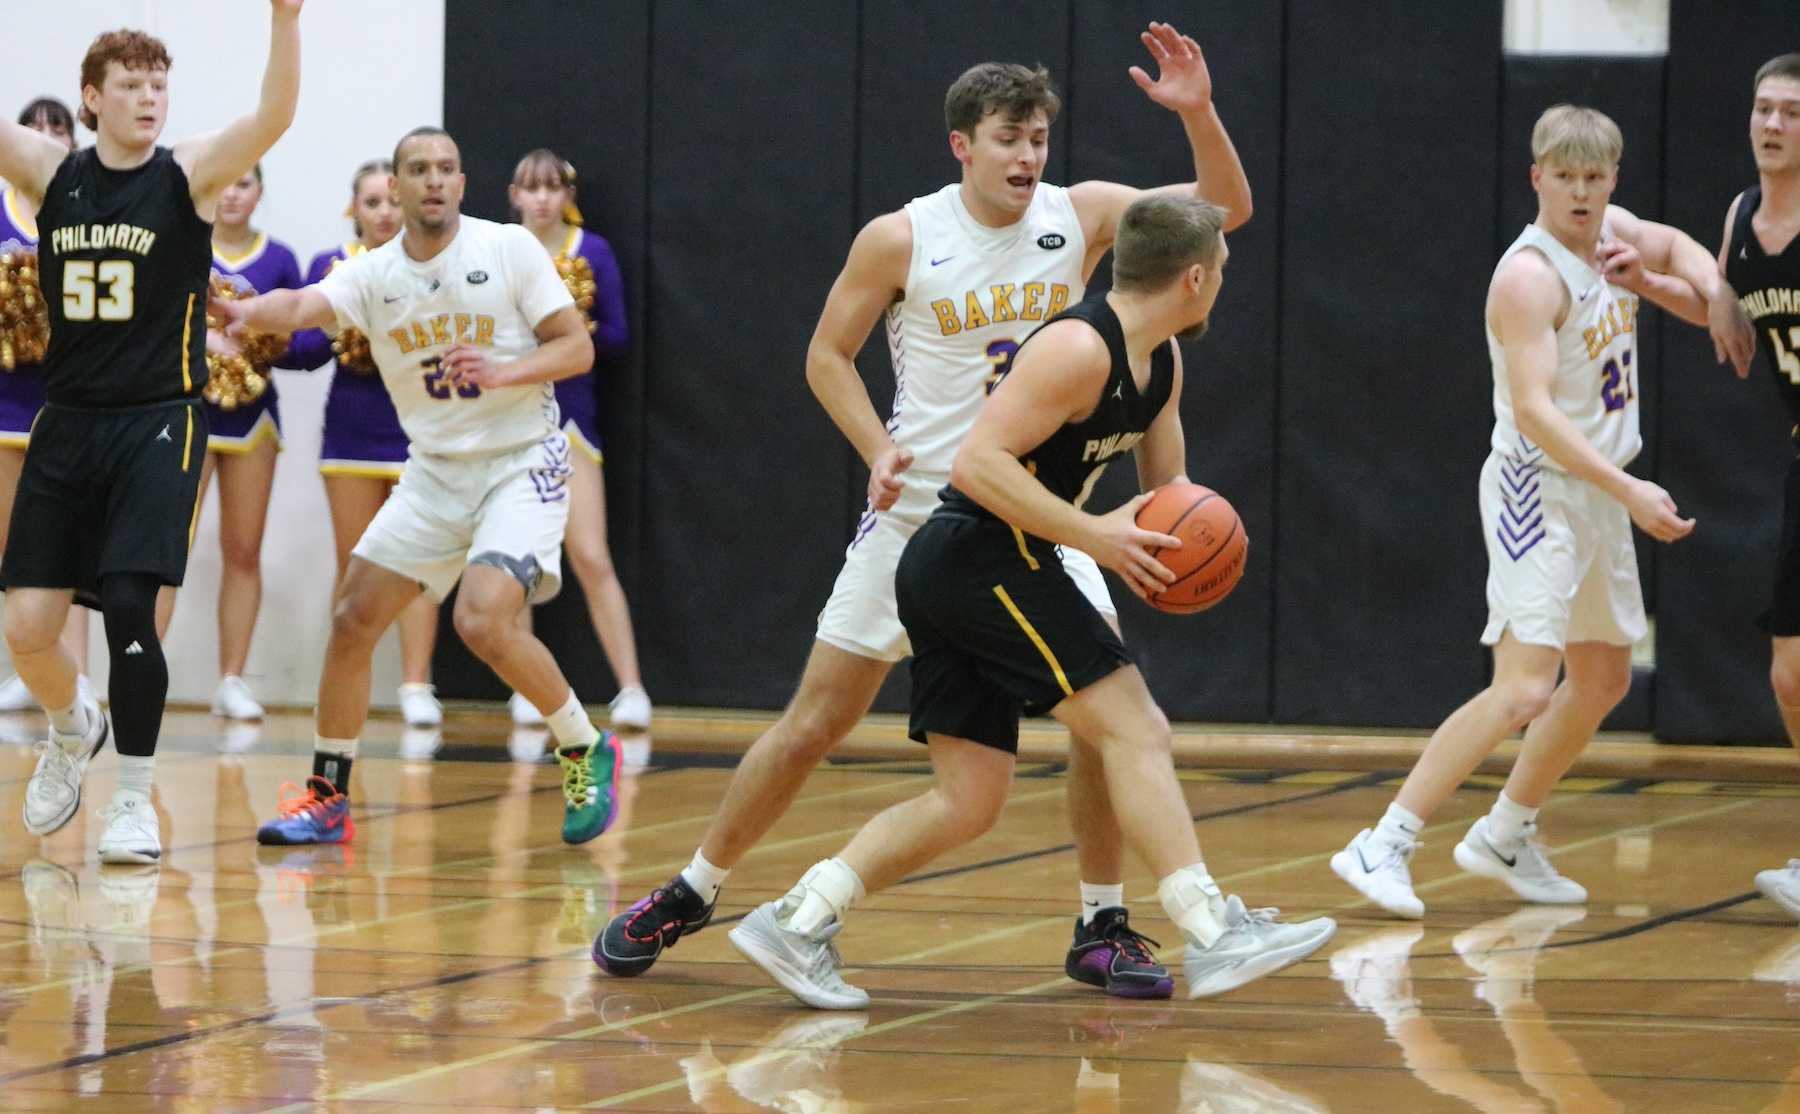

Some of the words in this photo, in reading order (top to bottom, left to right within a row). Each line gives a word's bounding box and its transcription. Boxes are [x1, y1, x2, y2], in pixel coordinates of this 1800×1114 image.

[52, 223, 156, 256] PHILOMATH
[1043, 237, 1061, 247] TCB
[63, 259, 135, 321] 53
[931, 281, 1069, 336] BAKER
[388, 312, 496, 355] BAKER
